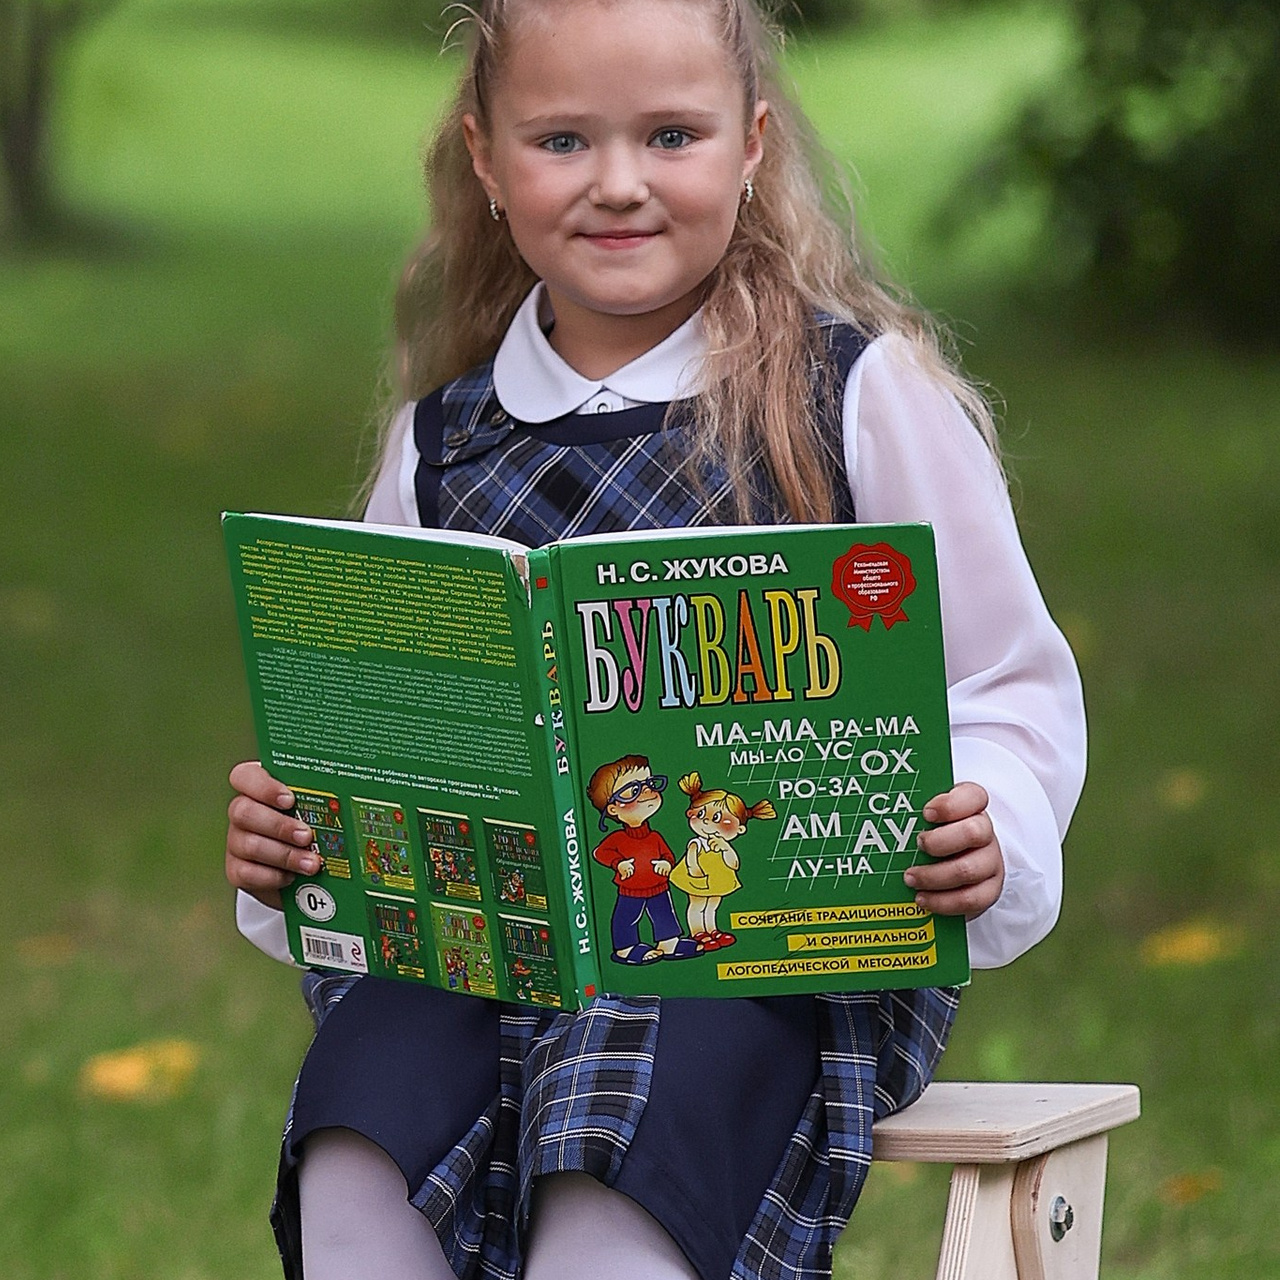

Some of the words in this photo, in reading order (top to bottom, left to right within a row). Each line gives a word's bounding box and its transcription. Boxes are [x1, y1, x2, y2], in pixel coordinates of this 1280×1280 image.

[597, 564, 625, 584] Н.
[630, 561, 657, 582] С.
[662, 553, 789, 580] ЖУКОВА
[576, 589, 842, 714] БУКВАРЬ
[541, 620, 569, 776] БУКВАРЬ
[695, 718, 818, 747] МА-МА
[830, 716, 920, 739] РА-МА
[730, 747, 804, 765] МЫ-ЛО
[815, 740, 854, 761] УС
[860, 748, 915, 775] ОХ
[779, 776, 864, 799] РО-ЗА
[868, 793, 914, 814] СА
[782, 812, 841, 840] АМ
[853, 817, 917, 854] АУ
[564, 808, 585, 905] ЖУКОВА
[788, 856, 873, 878] ЛУ-НА
[307, 893, 327, 911] 0+
[738, 911, 813, 926] СОЧЕТАНИЕ
[816, 905, 926, 922] ТРАДИЦИОННОЙ
[807, 937, 816, 946] И
[821, 929, 928, 946] ОРИГИНАЛЬНОЙ
[726, 958, 850, 976] ЛОГОПЕДИЧЕСКОЙ
[858, 956, 930, 969] МЕТОДИКИ
